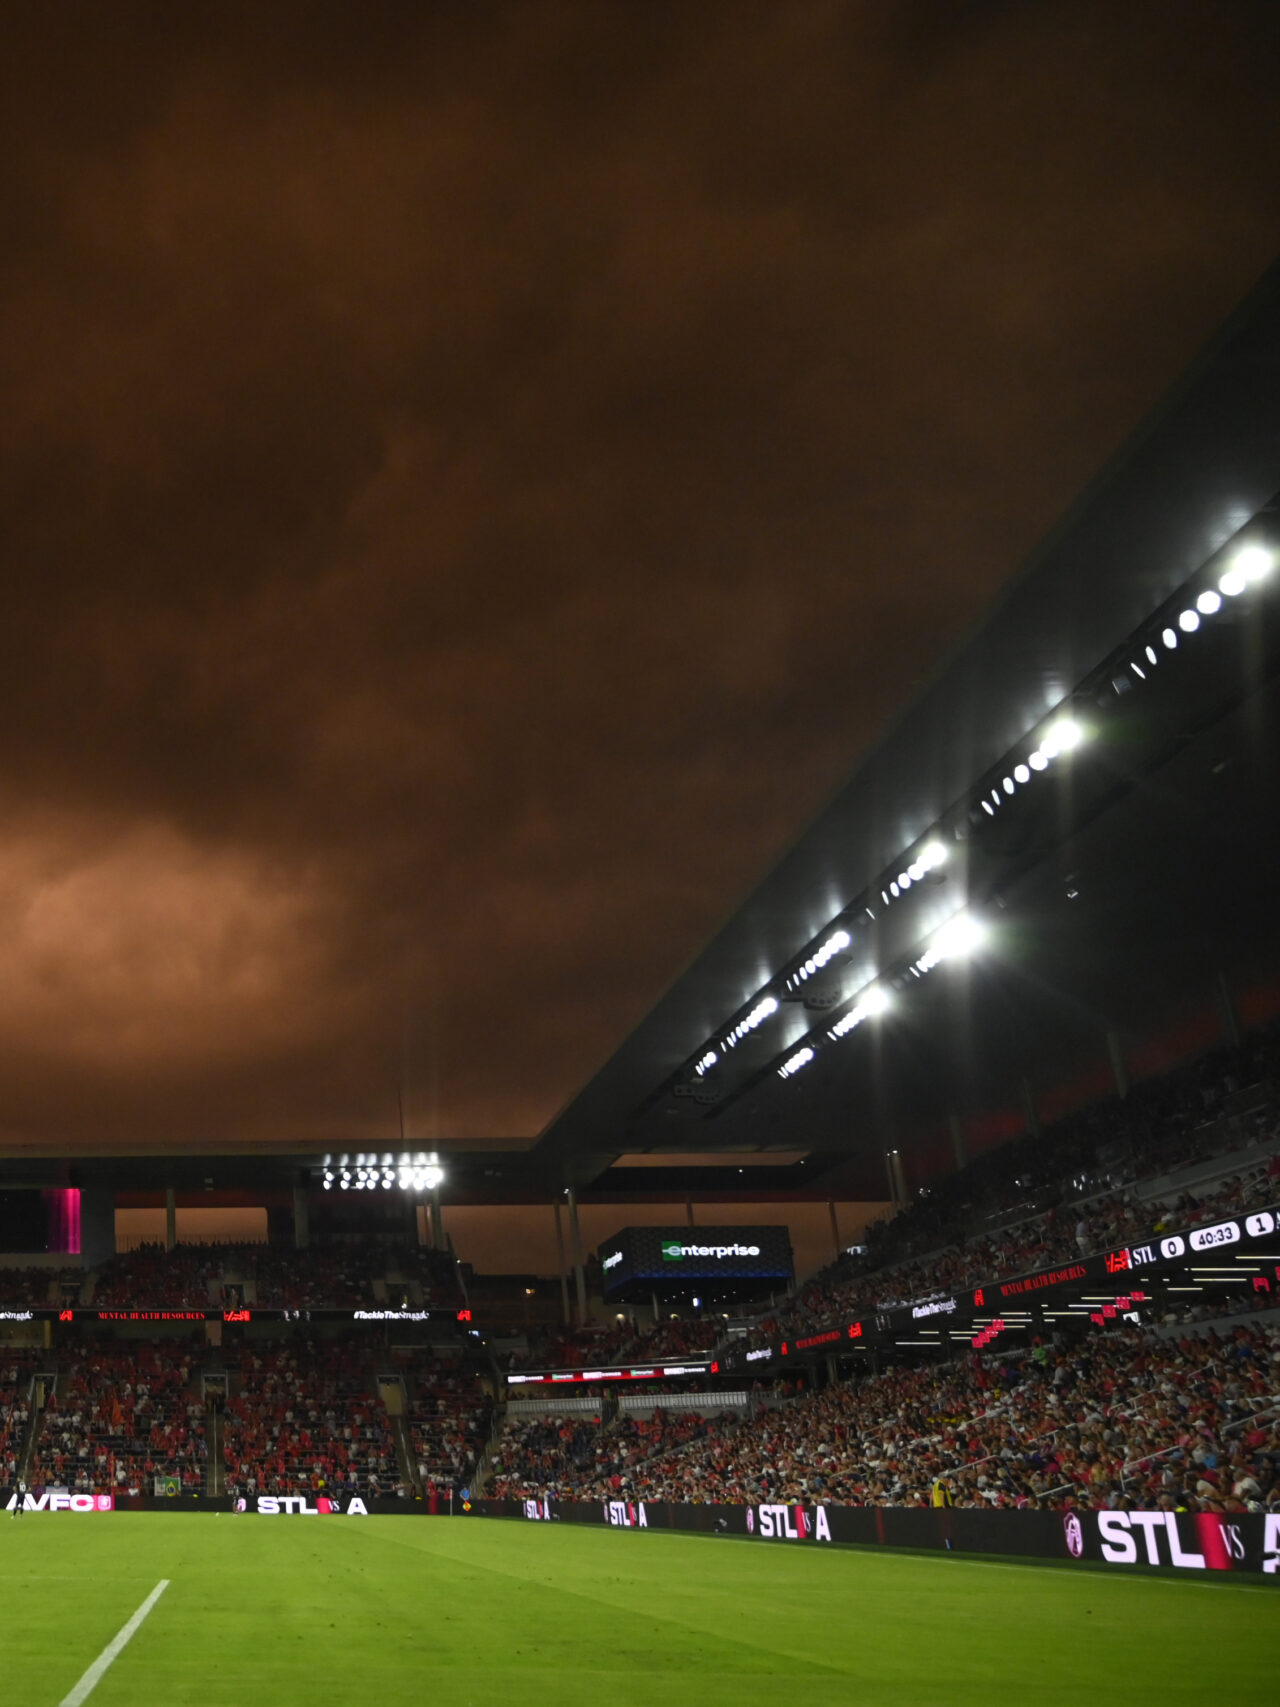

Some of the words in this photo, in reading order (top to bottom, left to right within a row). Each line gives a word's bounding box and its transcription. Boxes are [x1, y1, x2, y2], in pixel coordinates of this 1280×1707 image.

[663, 1243, 760, 1259] enterprise
[1133, 1246, 1157, 1266] STL
[1167, 1241, 1177, 1256] 0
[1198, 1227, 1233, 1246] 40:33
[1255, 1217, 1267, 1233] 1
[257, 1496, 319, 1514] STL
[347, 1497, 368, 1515] A
[609, 1501, 631, 1526] STL
[759, 1504, 798, 1538] STL
[816, 1505, 832, 1541] A
[1097, 1510, 1206, 1568] STL
[1218, 1524, 1245, 1560] VS
